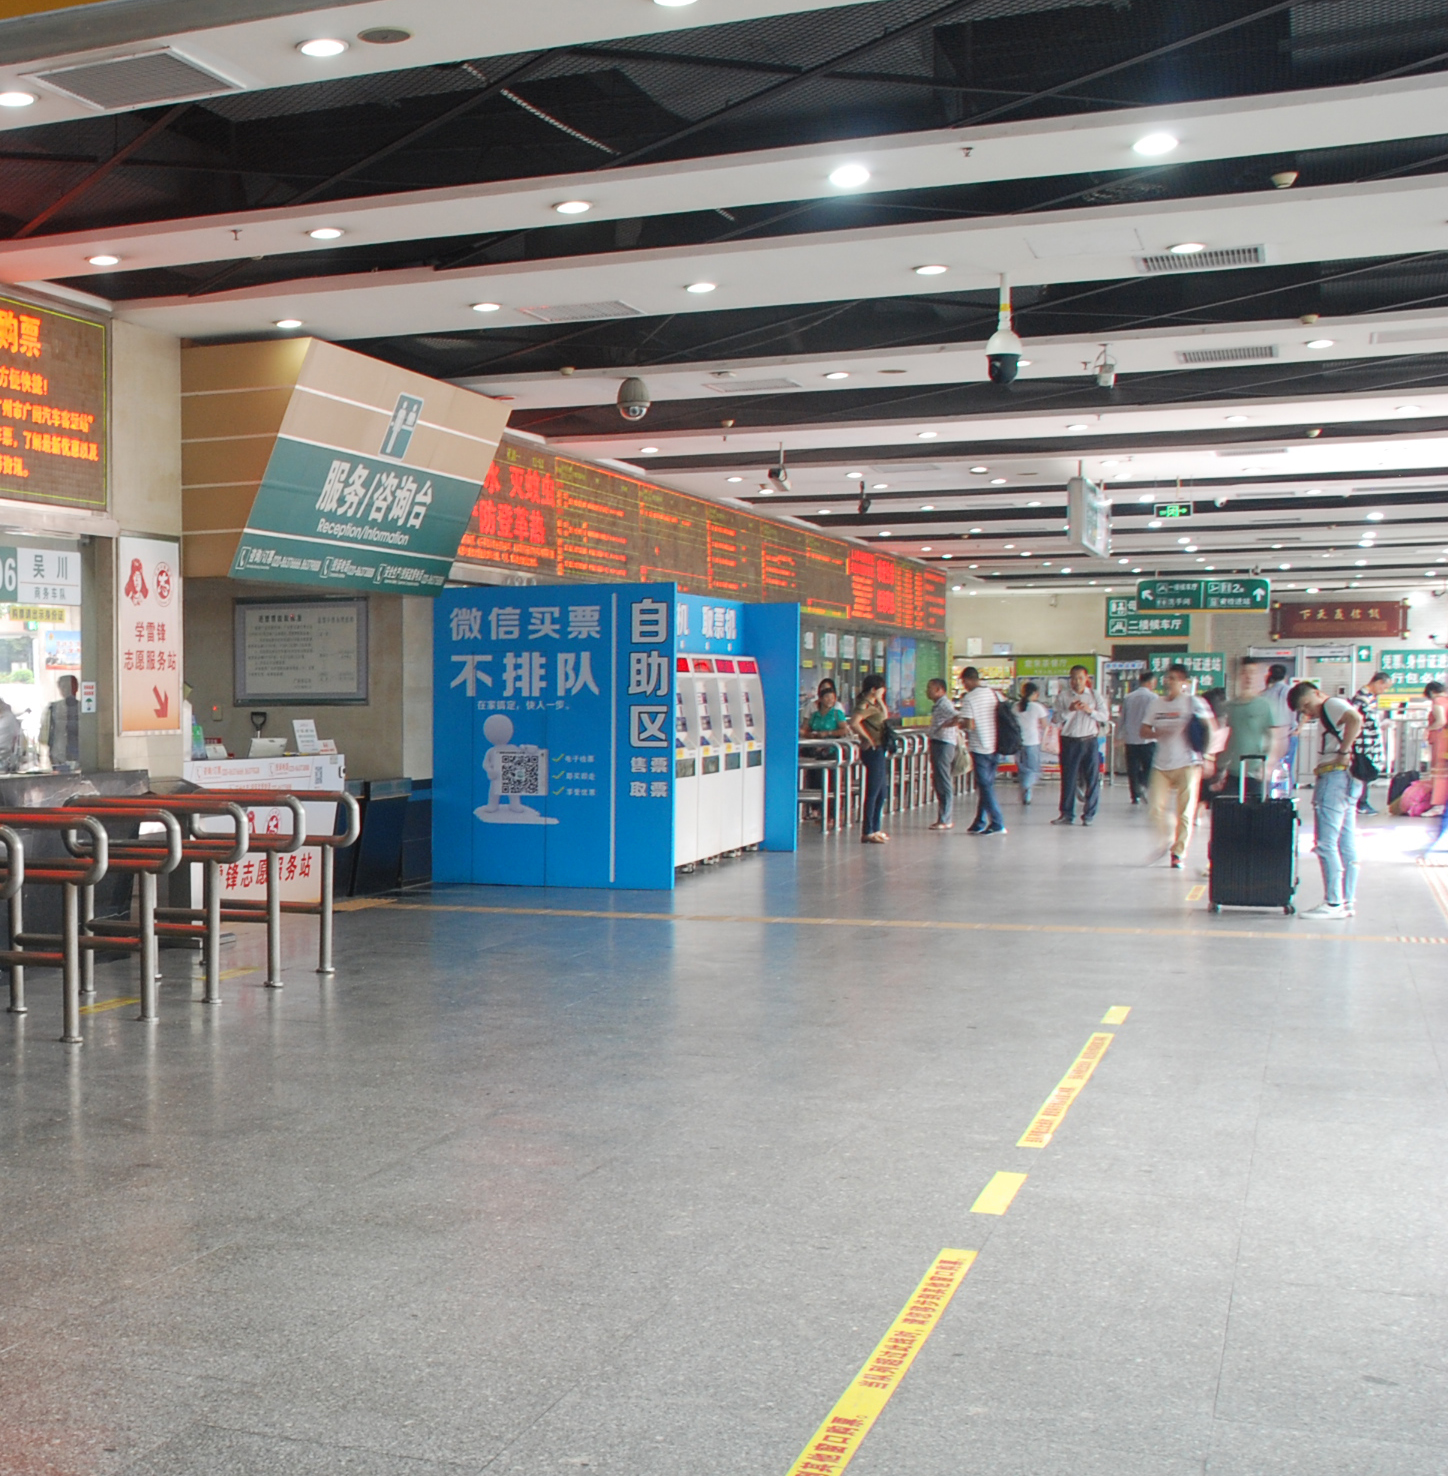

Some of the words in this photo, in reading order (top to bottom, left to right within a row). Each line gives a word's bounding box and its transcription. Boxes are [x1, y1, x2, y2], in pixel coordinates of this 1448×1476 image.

[315, 460, 434, 530] 服务/咨询台
[316, 517, 410, 547] Reception/Information
[471, 498, 547, 545] 防登革热
[31, 556, 69, 581] 吴川
[33, 586, 68, 600] 商务车队
[10, 607, 64, 624] 购票请出示身份证
[450, 605, 602, 641] 微信买票
[702, 605, 737, 640] 取票机
[1127, 619, 1183, 631] 二楼候车厅
[134, 621, 167, 643] 学雷锋
[123, 649, 178, 672] 志愿服务站
[450, 651, 600, 697] 不排队
[628, 598, 670, 749] 自助区
[630, 756, 669, 774] 售票
[629, 780, 669, 798] 取票
[218, 852, 313, 891] 锋志愿务站
